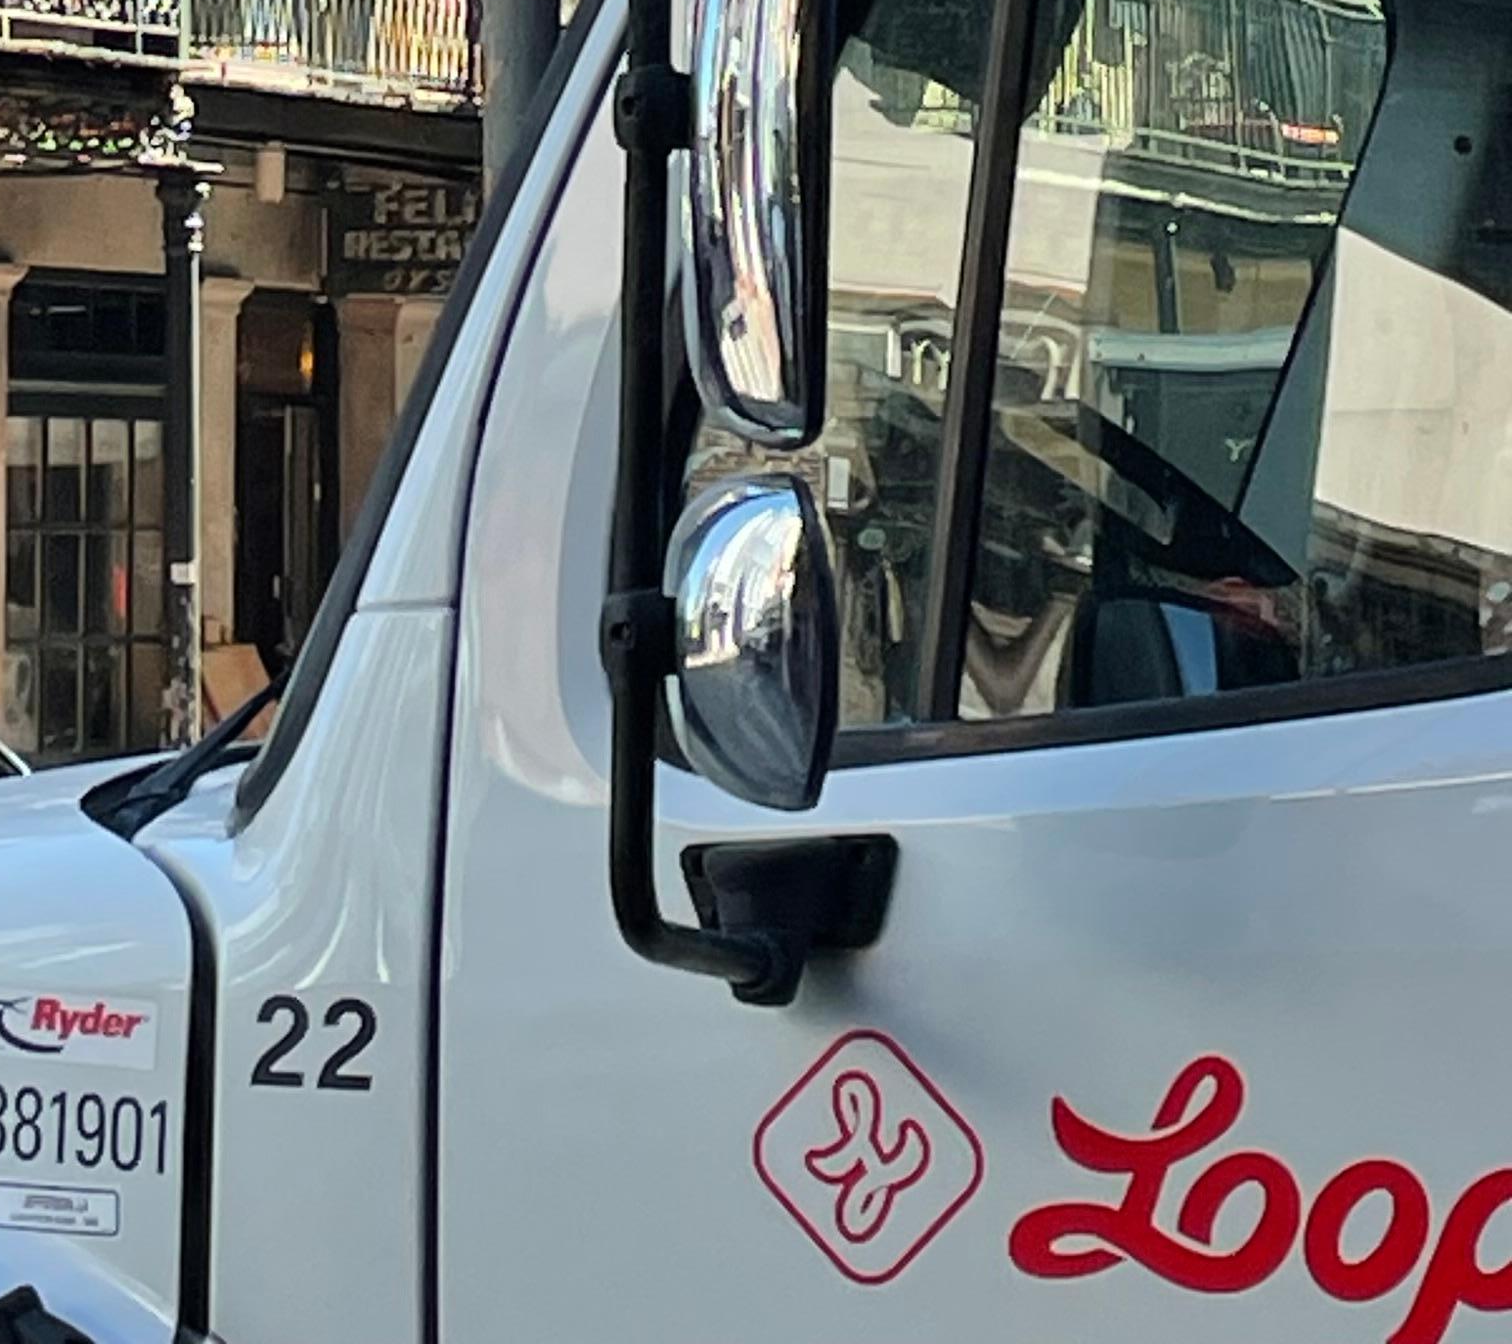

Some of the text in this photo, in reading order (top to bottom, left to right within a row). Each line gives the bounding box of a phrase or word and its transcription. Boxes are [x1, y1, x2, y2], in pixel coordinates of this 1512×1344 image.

[344, 229, 480, 262] RESTA
[29, 997, 144, 1041] Ryder
[249, 994, 378, 1092] 22
